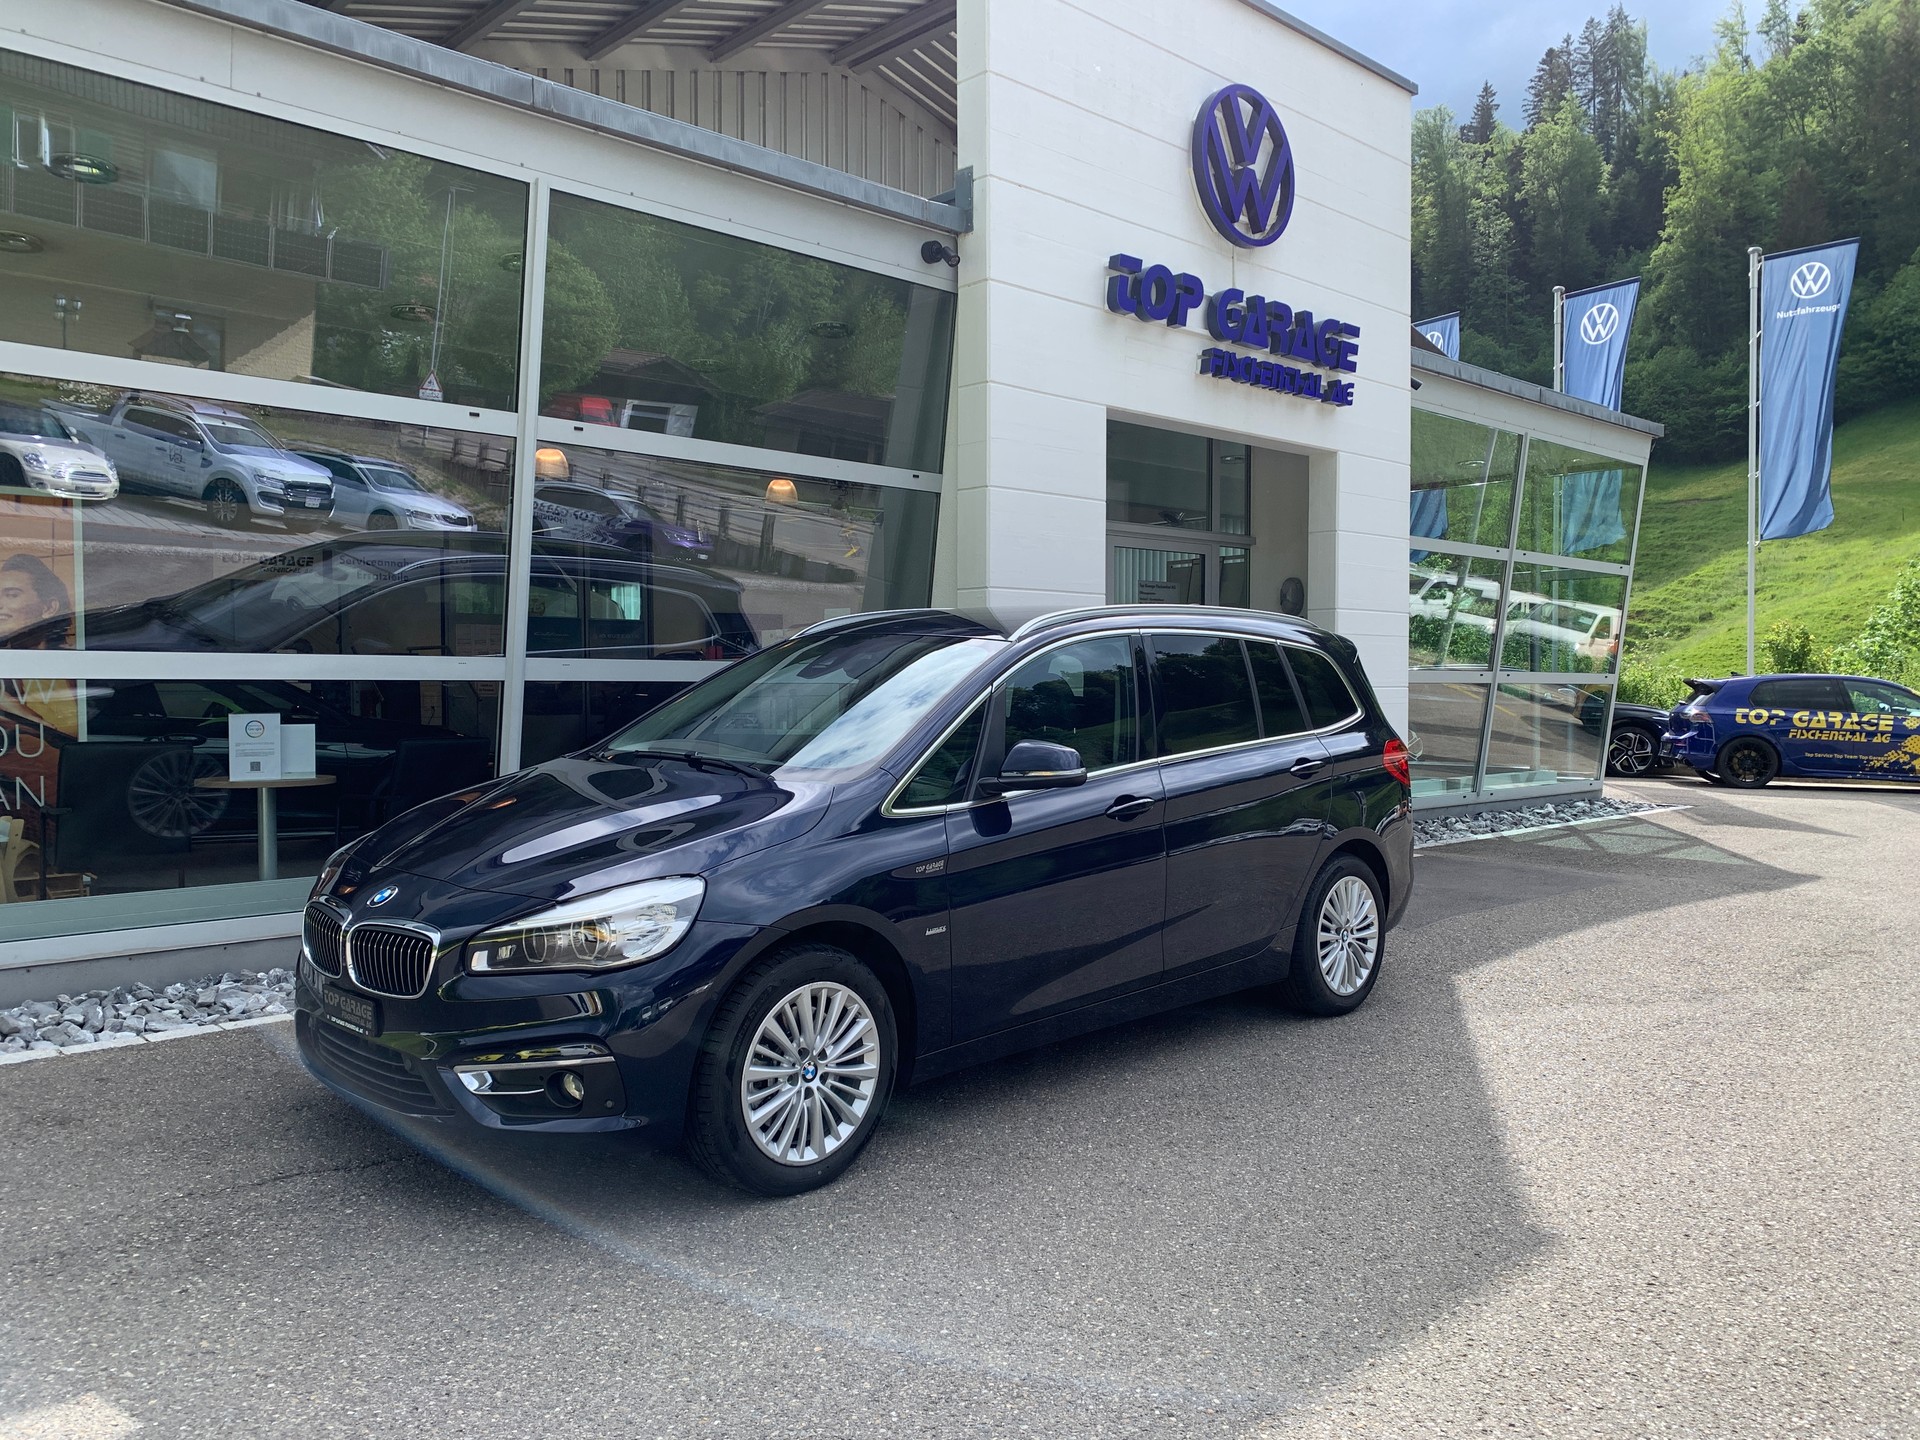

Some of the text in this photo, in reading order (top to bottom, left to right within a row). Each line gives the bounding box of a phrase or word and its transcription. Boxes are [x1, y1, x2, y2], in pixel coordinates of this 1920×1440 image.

[1106, 253, 1361, 373] TOP GARAGE
[1201, 347, 1354, 407] FISCHENTHAL AG
[1735, 708, 1894, 731] TOP GARAGE
[1789, 729, 1891, 743] FISCHENTHAL AG
[324, 989, 372, 1021] TOP GARAGE
